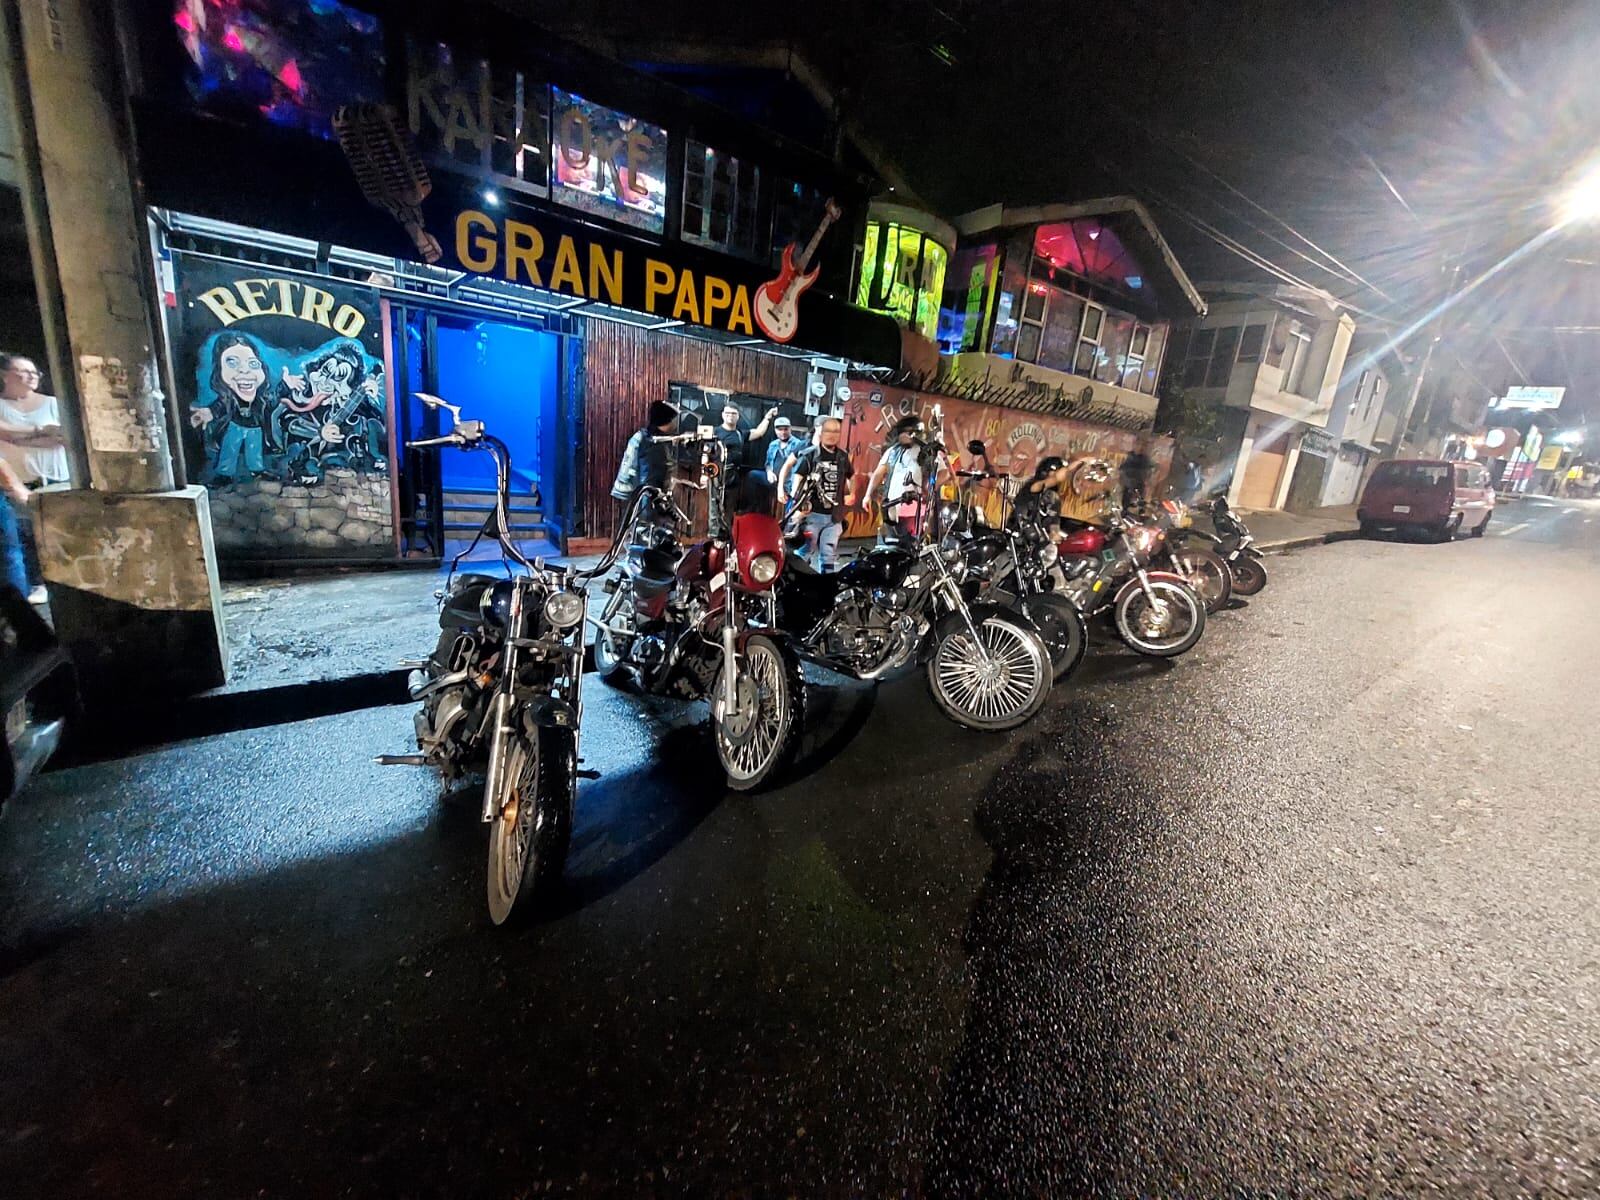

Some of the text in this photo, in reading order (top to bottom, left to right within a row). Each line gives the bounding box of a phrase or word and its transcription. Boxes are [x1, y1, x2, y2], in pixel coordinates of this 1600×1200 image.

[456, 209, 754, 335] GRAN PAPA
[197, 278, 366, 338] RETRO
[1010, 424, 1042, 444] ROLLING
